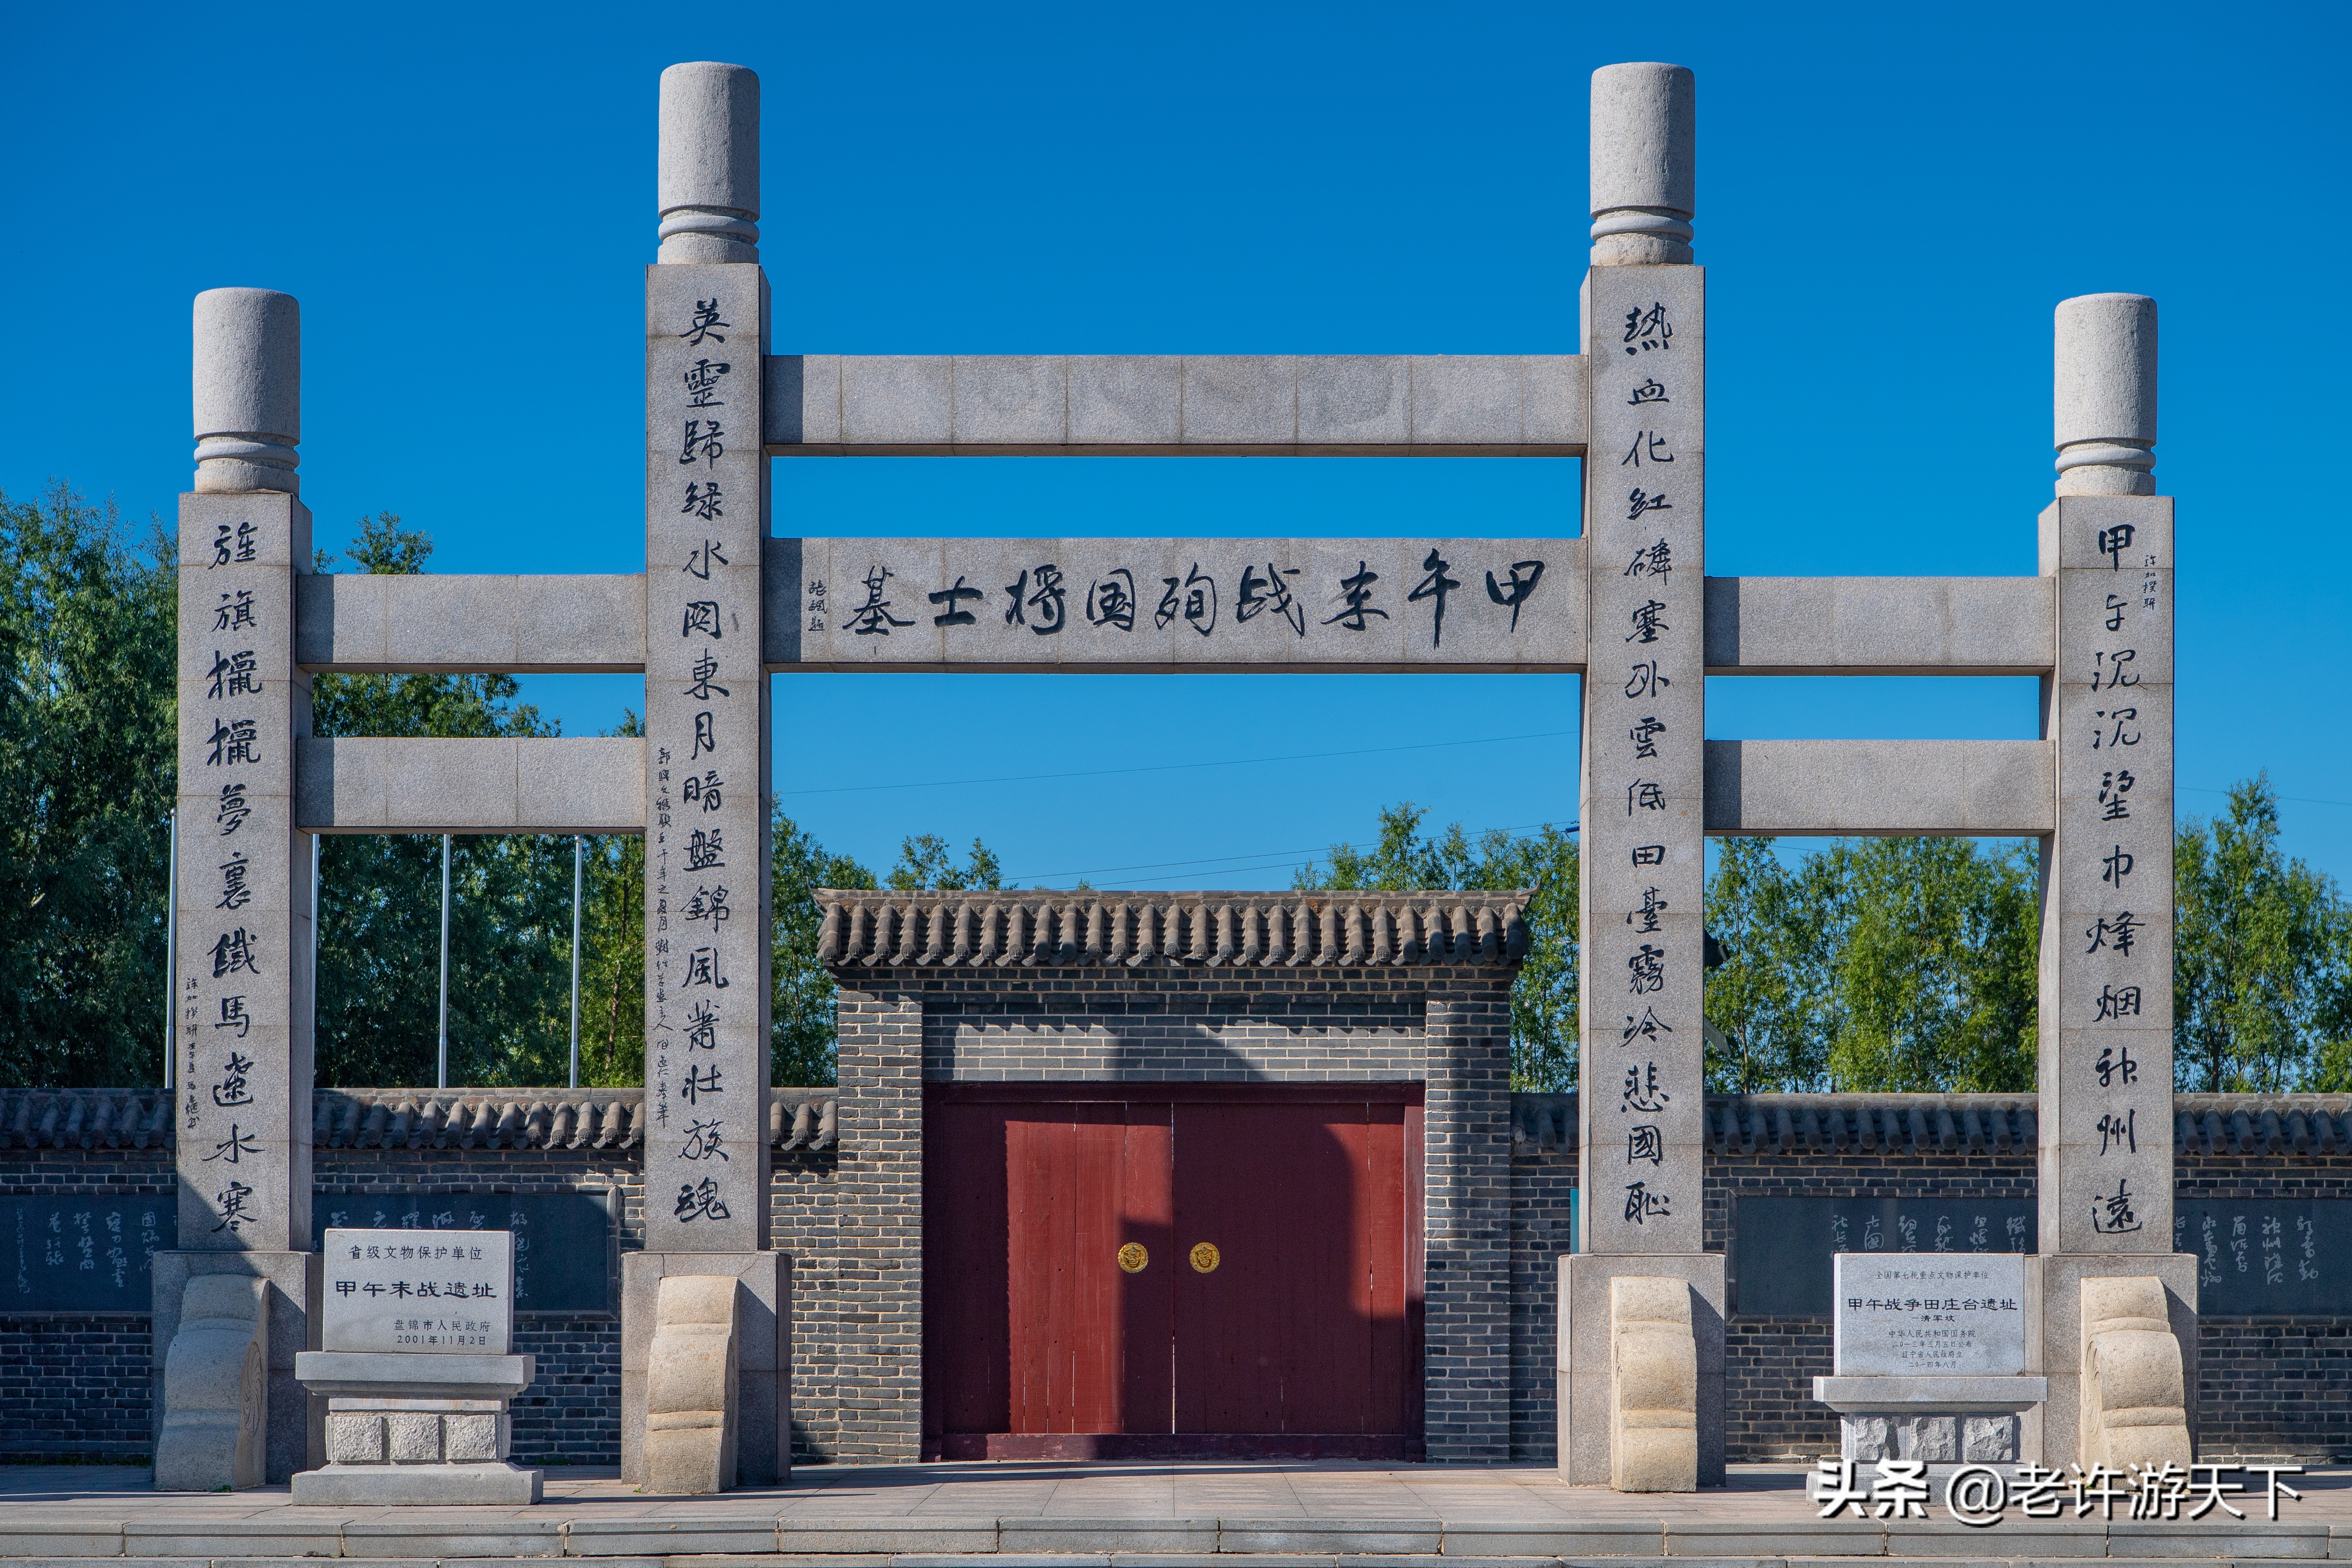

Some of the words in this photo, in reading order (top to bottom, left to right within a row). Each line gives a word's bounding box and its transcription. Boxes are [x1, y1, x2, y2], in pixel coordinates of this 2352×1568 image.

[348, 1245, 483, 1260] 省级文物保护单位
[1875, 1270, 1990, 1280] 全国第七批重点文物保护单位
[335, 1281, 498, 1299] 甲午末战遗址
[1847, 1298, 2018, 1312] 甲午战争田庄台遗址
[394, 1319, 491, 1333] 盘锦市人民政府
[1888, 1329, 1976, 1338] 中华人民共和国国务院
[397, 1335, 486, 1346] 2001年11月2日
[1902, 1350, 1963, 1359] 辽宁省人民政府立
